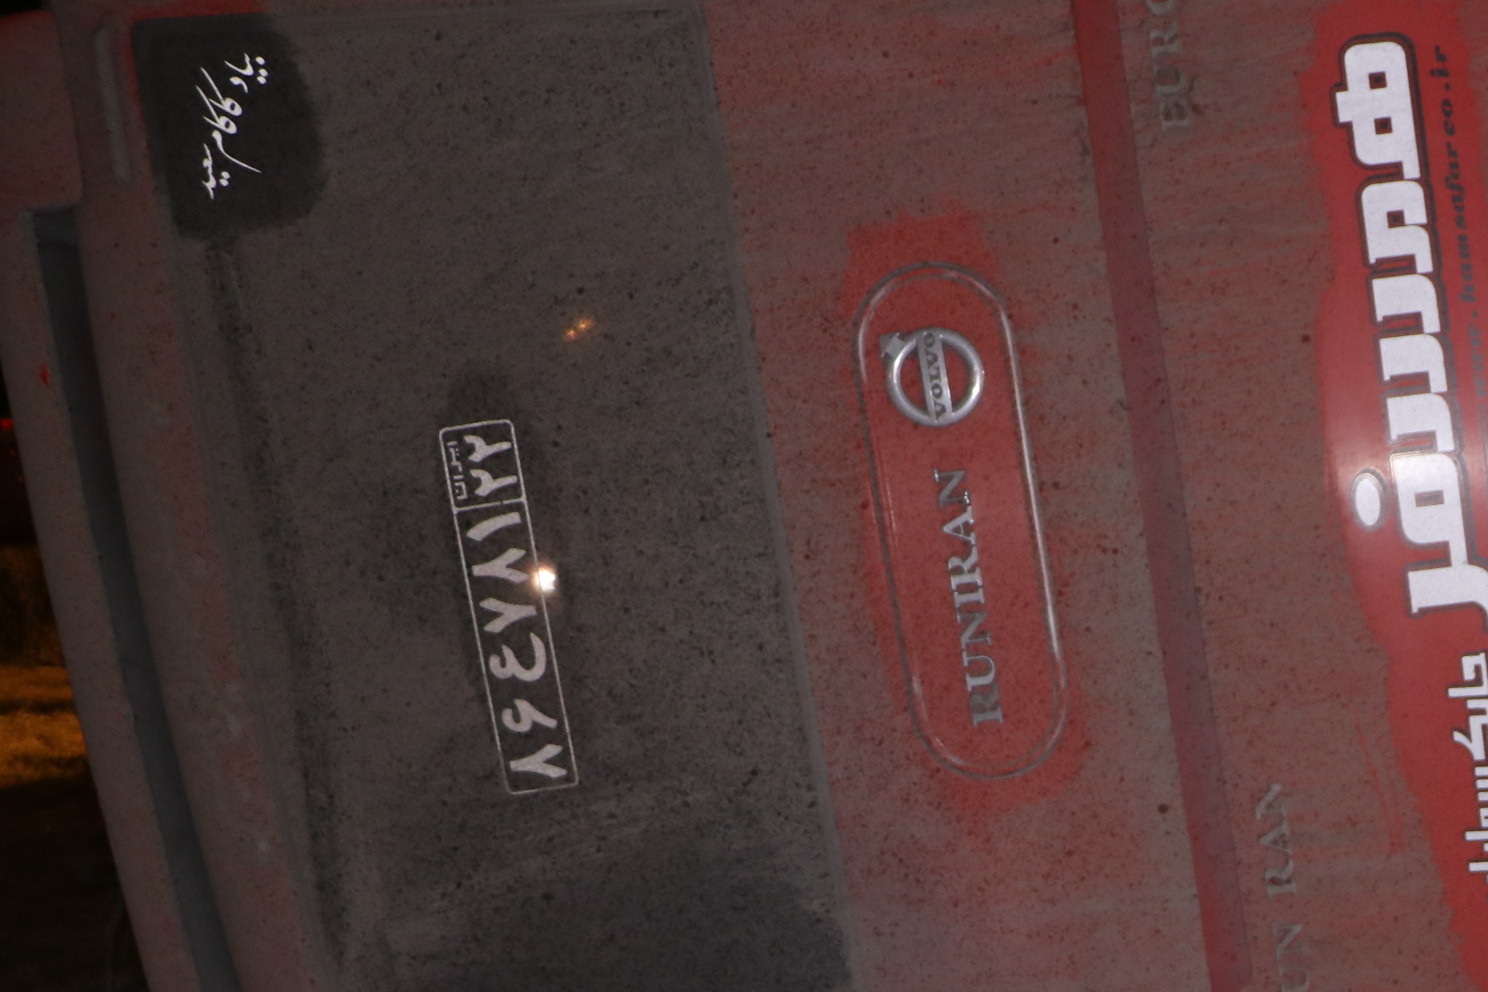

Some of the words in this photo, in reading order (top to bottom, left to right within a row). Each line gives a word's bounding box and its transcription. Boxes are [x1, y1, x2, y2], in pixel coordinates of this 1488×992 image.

[924, 332, 947, 420] VOLVO
[465, 434, 518, 497] ۲۲
[932, 466, 1004, 728] RUNIRAN
